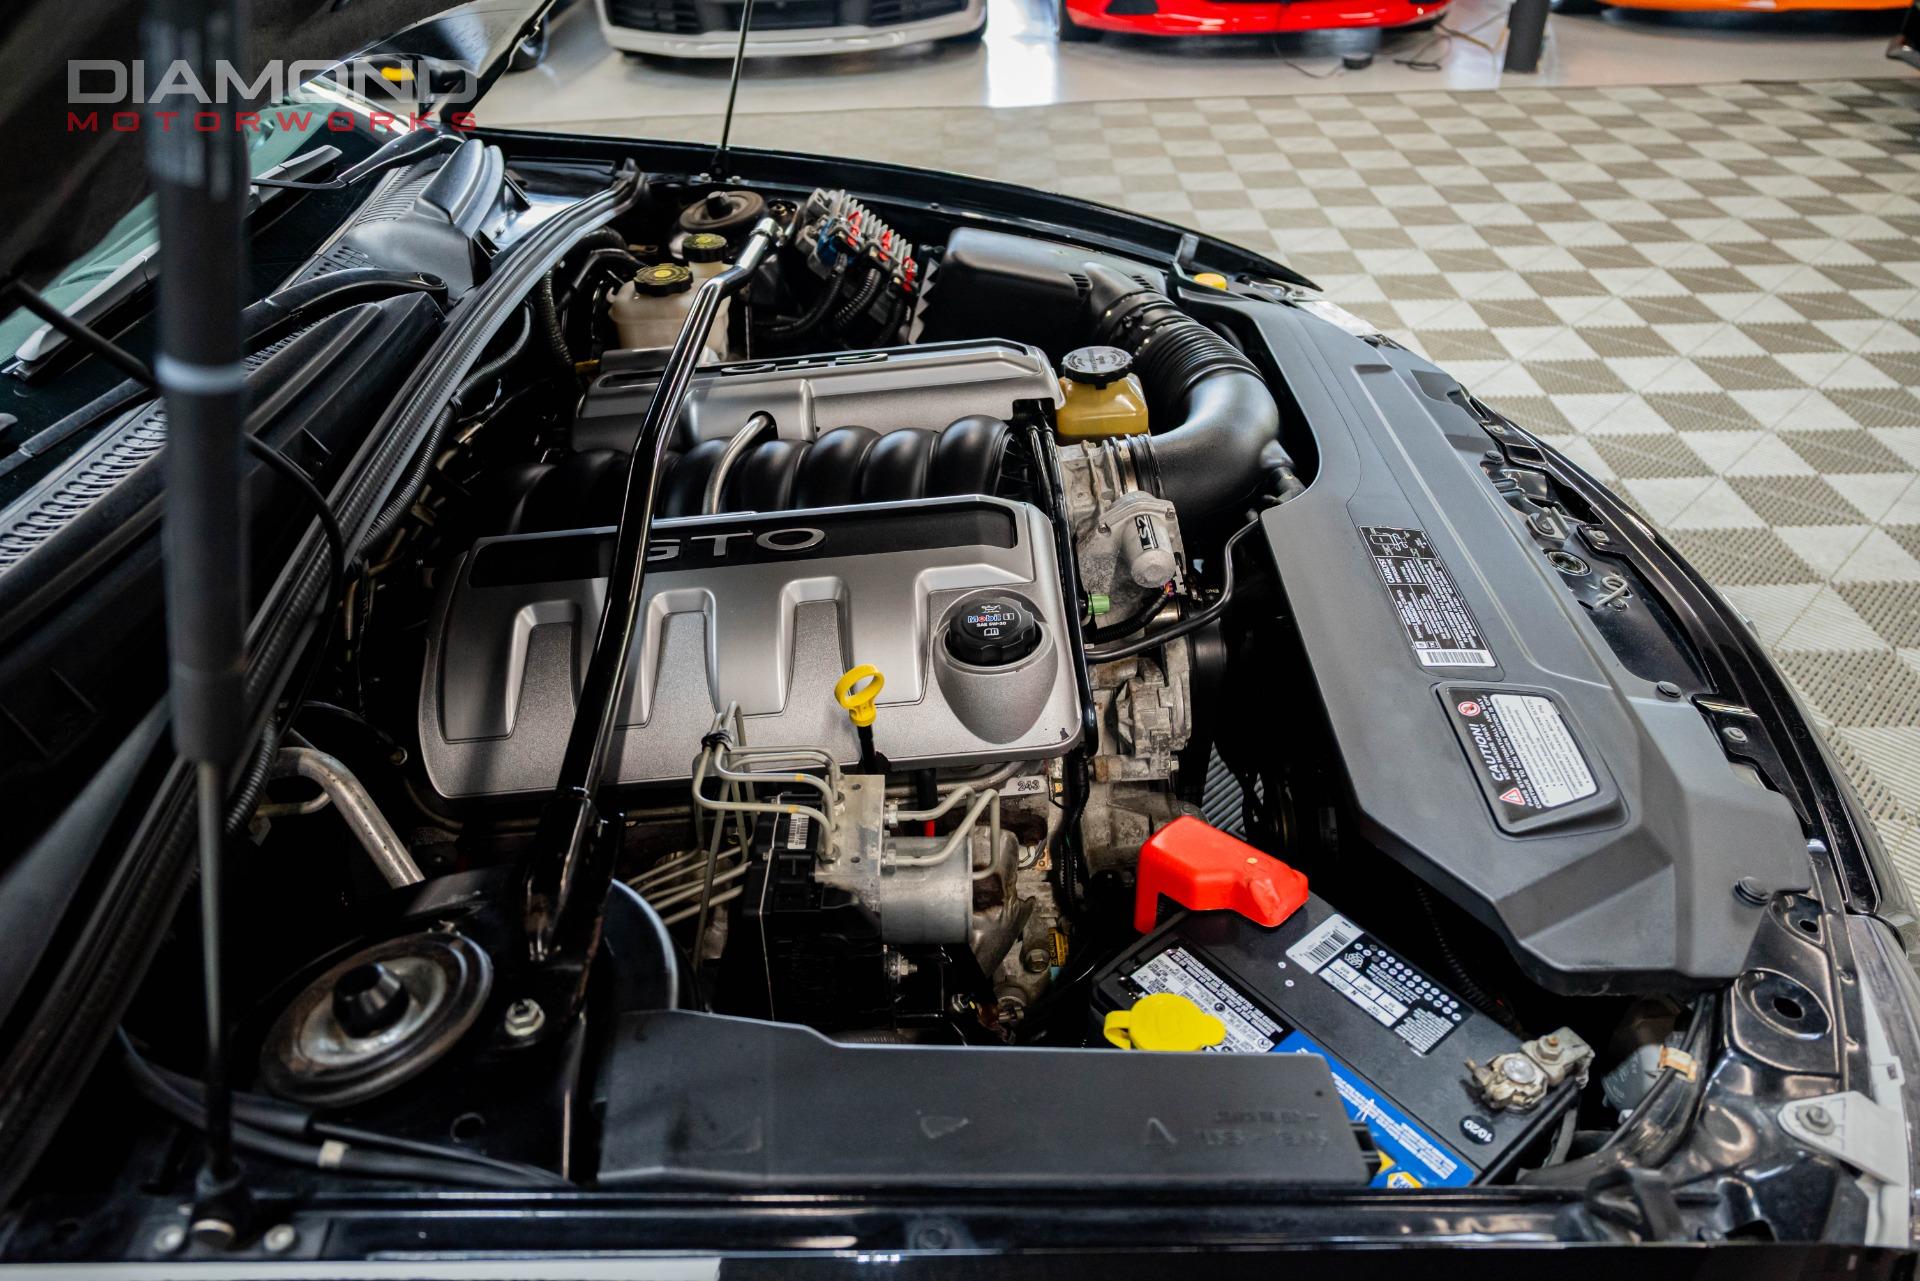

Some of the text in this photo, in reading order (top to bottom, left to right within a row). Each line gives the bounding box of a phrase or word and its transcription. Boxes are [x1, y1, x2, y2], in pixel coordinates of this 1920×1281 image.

[1137, 515, 1154, 549] LS2
[967, 613, 1002, 623] Mobil
[1469, 723, 1505, 782] CAUTION!
[1479, 723, 1511, 780] KEEP HANDS AWAY
[1502, 737, 1515, 754] WHEN
[1018, 780, 1040, 792] 243
[1511, 768, 1525, 788] START
